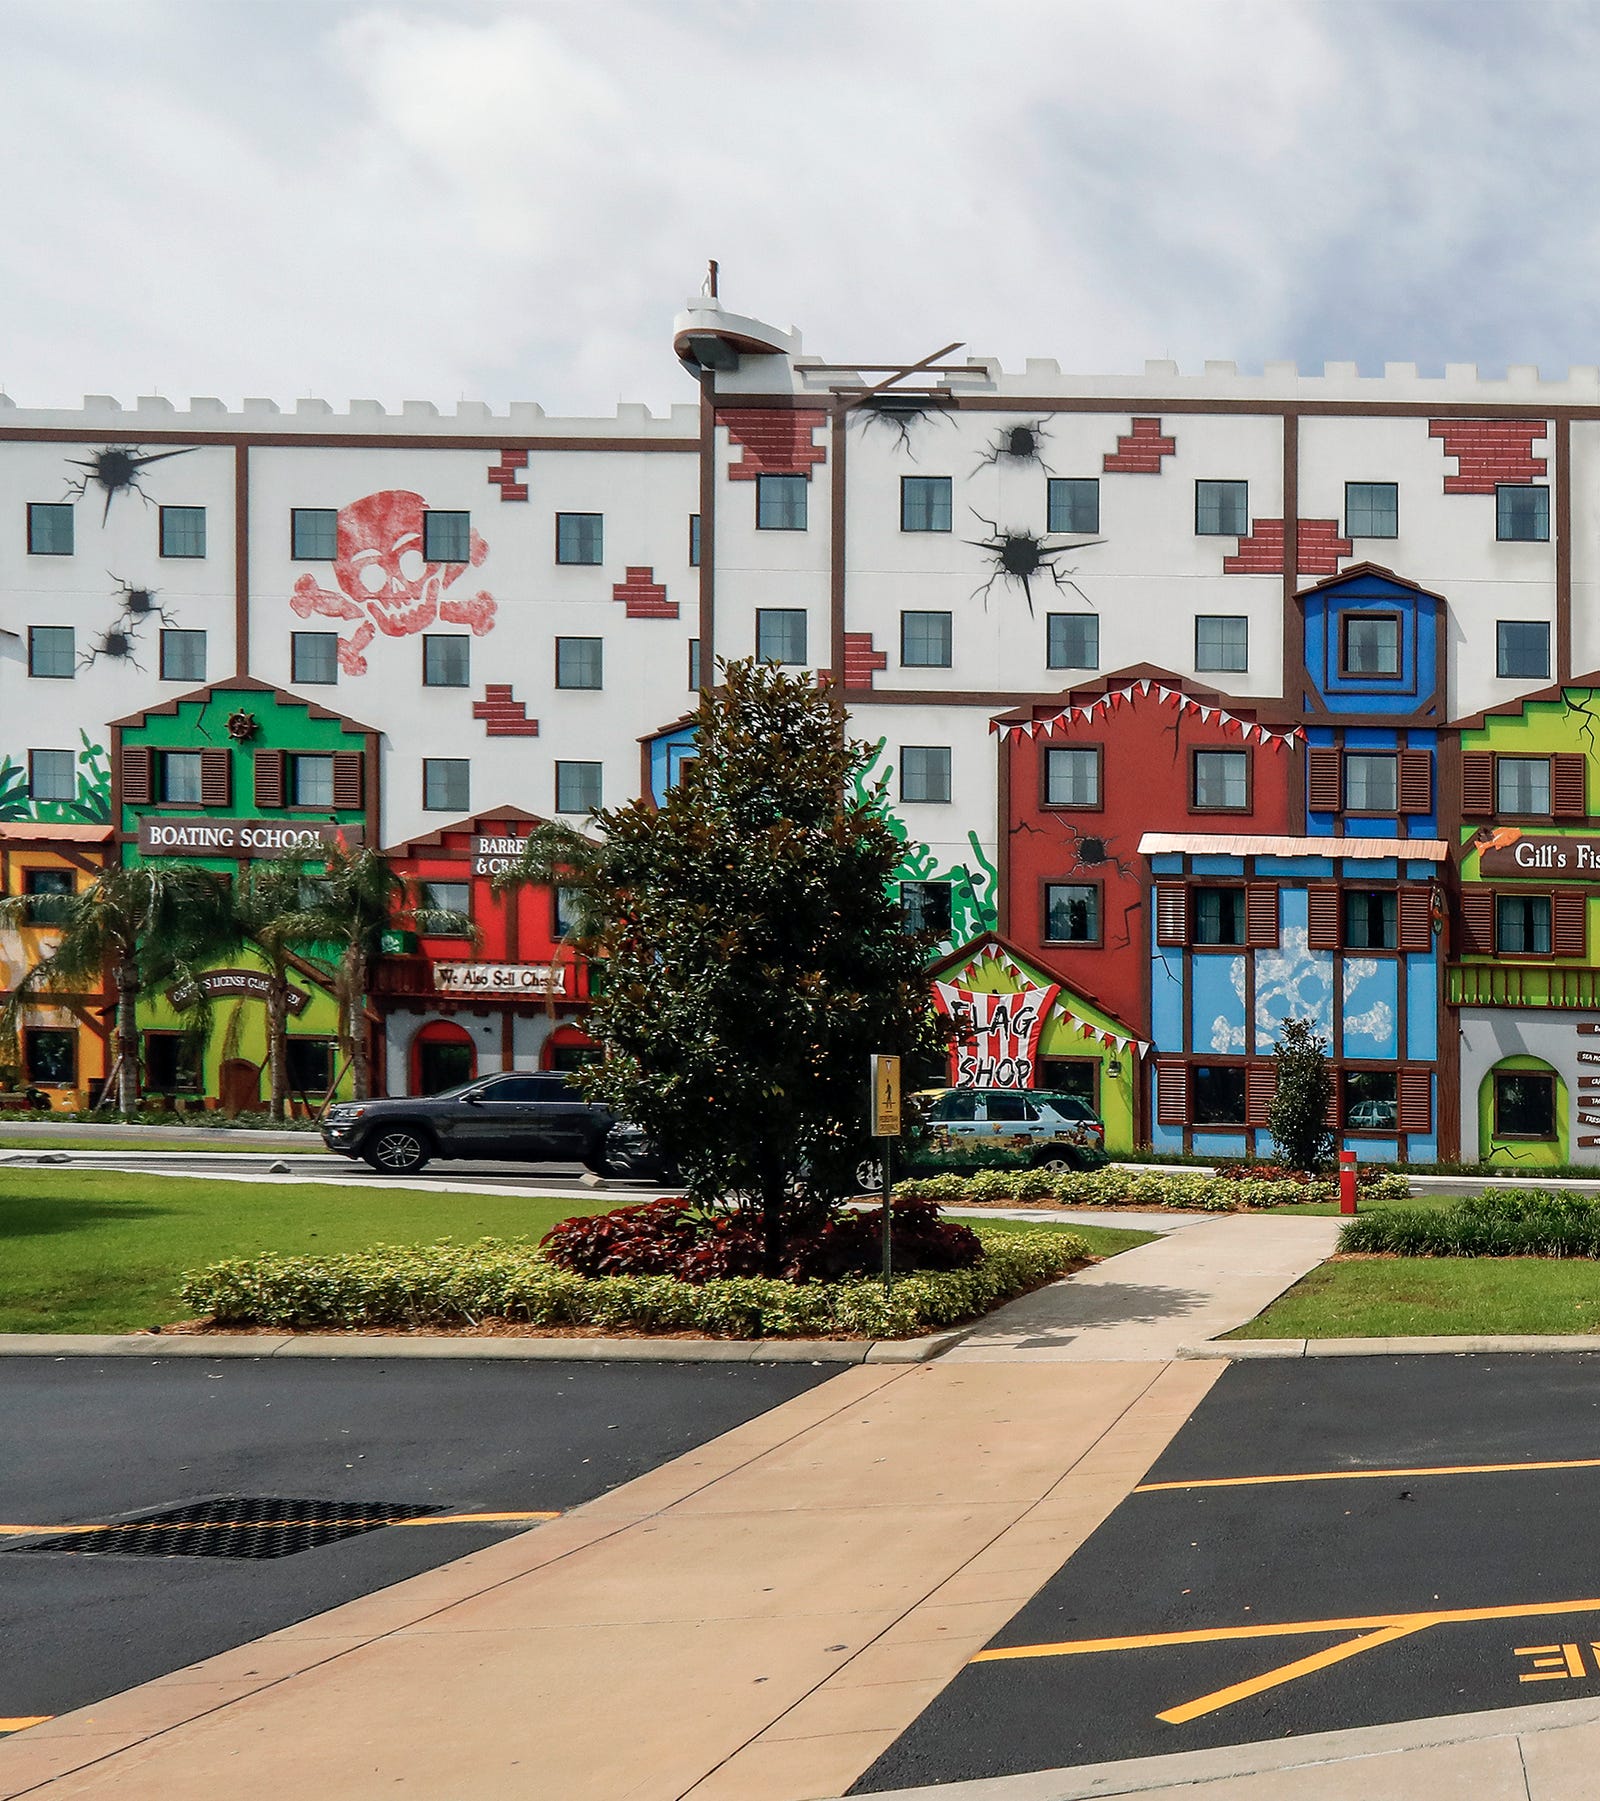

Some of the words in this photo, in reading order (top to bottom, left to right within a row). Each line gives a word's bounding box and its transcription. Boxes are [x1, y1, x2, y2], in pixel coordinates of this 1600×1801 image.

[149, 826, 234, 847] BOATING
[240, 828, 325, 850] SCHOOL
[1515, 842, 1567, 868] Gill's
[476, 858, 487, 874] &
[213, 976, 246, 988] LICENSE
[438, 969, 458, 984] We
[463, 970, 488, 985] Also
[493, 970, 515, 986] Sell
[950, 1000, 1037, 1040] FLAG
[1582, 1053, 1592, 1061] SEA
[957, 1057, 1031, 1088] SHOP
